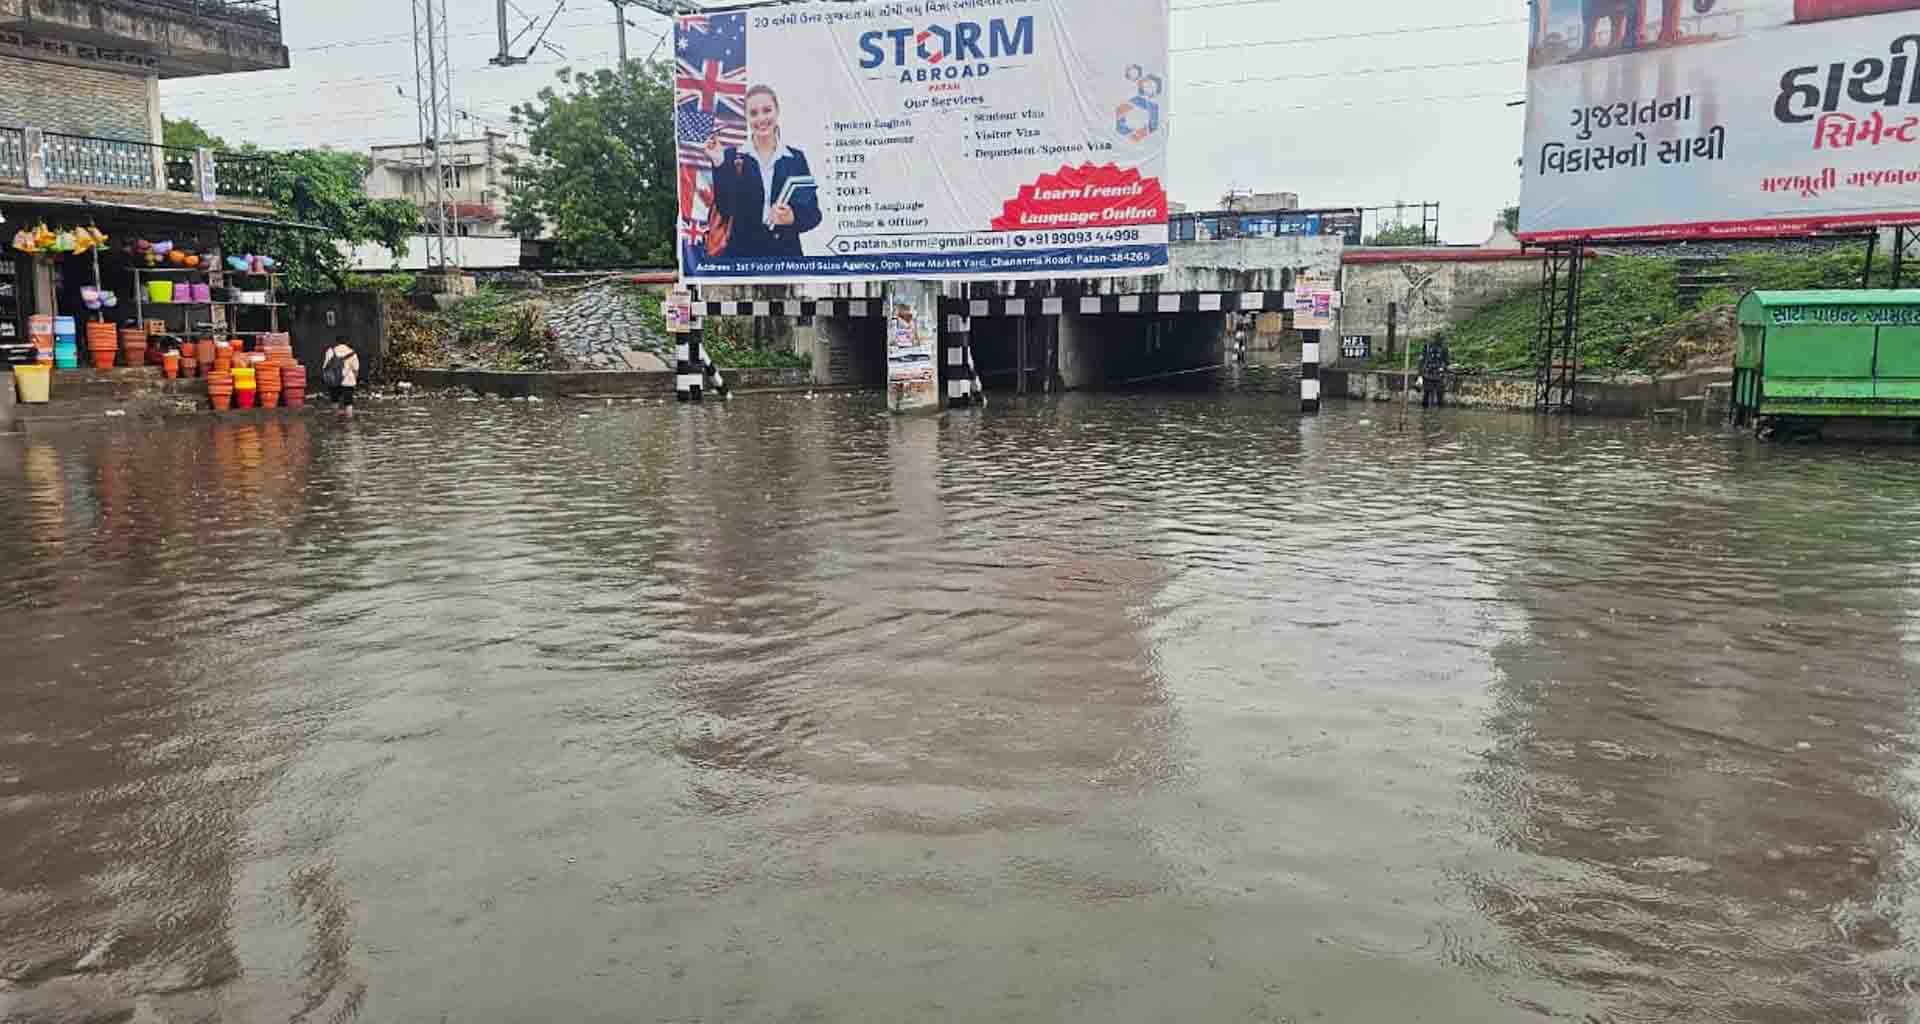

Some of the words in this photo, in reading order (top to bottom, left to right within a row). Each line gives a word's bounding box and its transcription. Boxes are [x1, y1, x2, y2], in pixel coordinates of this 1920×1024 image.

[859, 16, 1034, 69] STORM
[900, 63, 990, 83] ABROAD
[904, 97, 929, 109] Our
[931, 94, 985, 107] Services
[1569, 95, 1691, 140] ગુજરાતના
[975, 130, 1013, 141] Visitor
[1016, 128, 1041, 138] Visa
[1087, 141, 1113, 152] Visa
[1539, 131, 1648, 176] વિકાસનો
[1657, 125, 1726, 164] સાથી
[1033, 186, 1082, 201] Learn
[1084, 181, 1144, 198] French
[1019, 211, 1100, 226] Language
[1102, 205, 1158, 221] Online
[775, 261, 785, 271] of
[927, 258, 961, 268] Market
